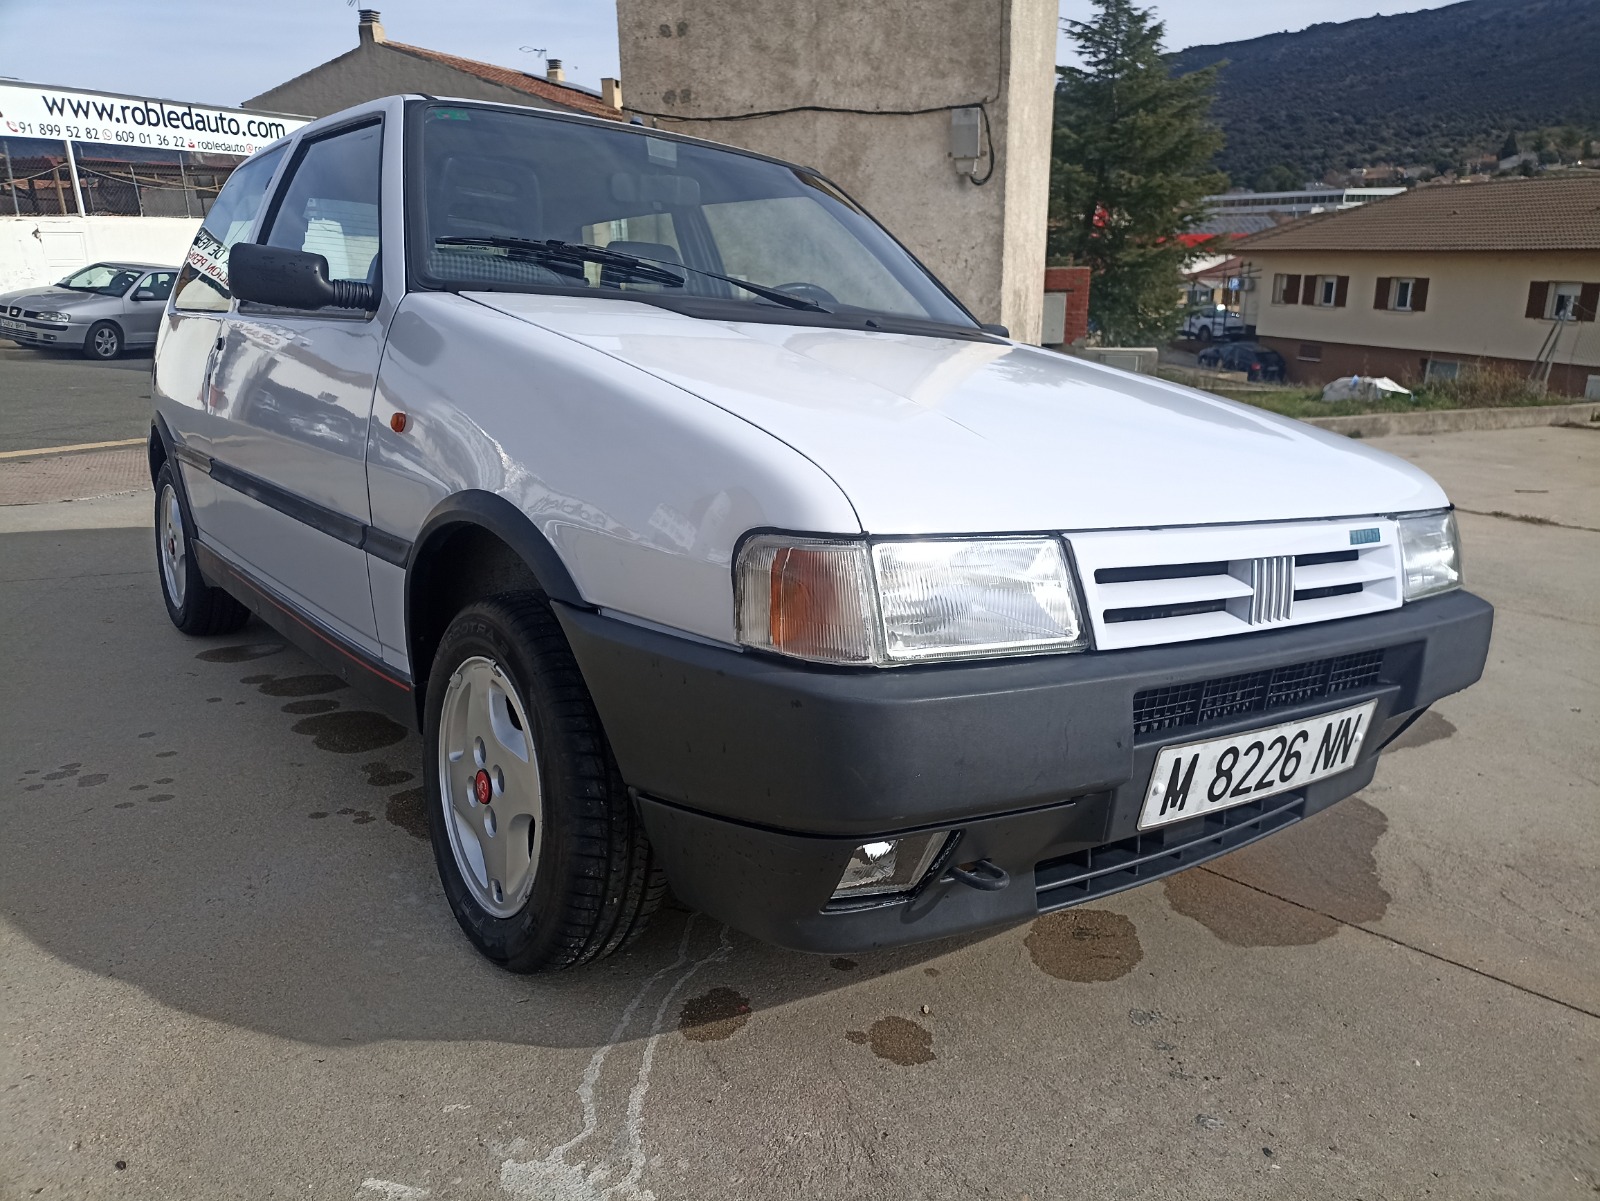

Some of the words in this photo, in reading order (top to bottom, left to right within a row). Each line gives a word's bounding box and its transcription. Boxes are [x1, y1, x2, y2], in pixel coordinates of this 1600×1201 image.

[19, 121, 33, 134] 91
[39, 123, 60, 136] 899
[66, 125, 81, 138] 52
[85, 127, 100, 140] 82
[115, 130, 135, 143] 609
[139, 132, 152, 145] 01
[156, 134, 170, 146] 36
[173, 135, 186, 148] 22
[41, 95, 286, 139] www.robledauto.com
[1159, 752, 1200, 817] M
[1206, 728, 1310, 803] 8226
[1309, 713, 1363, 775] NN
